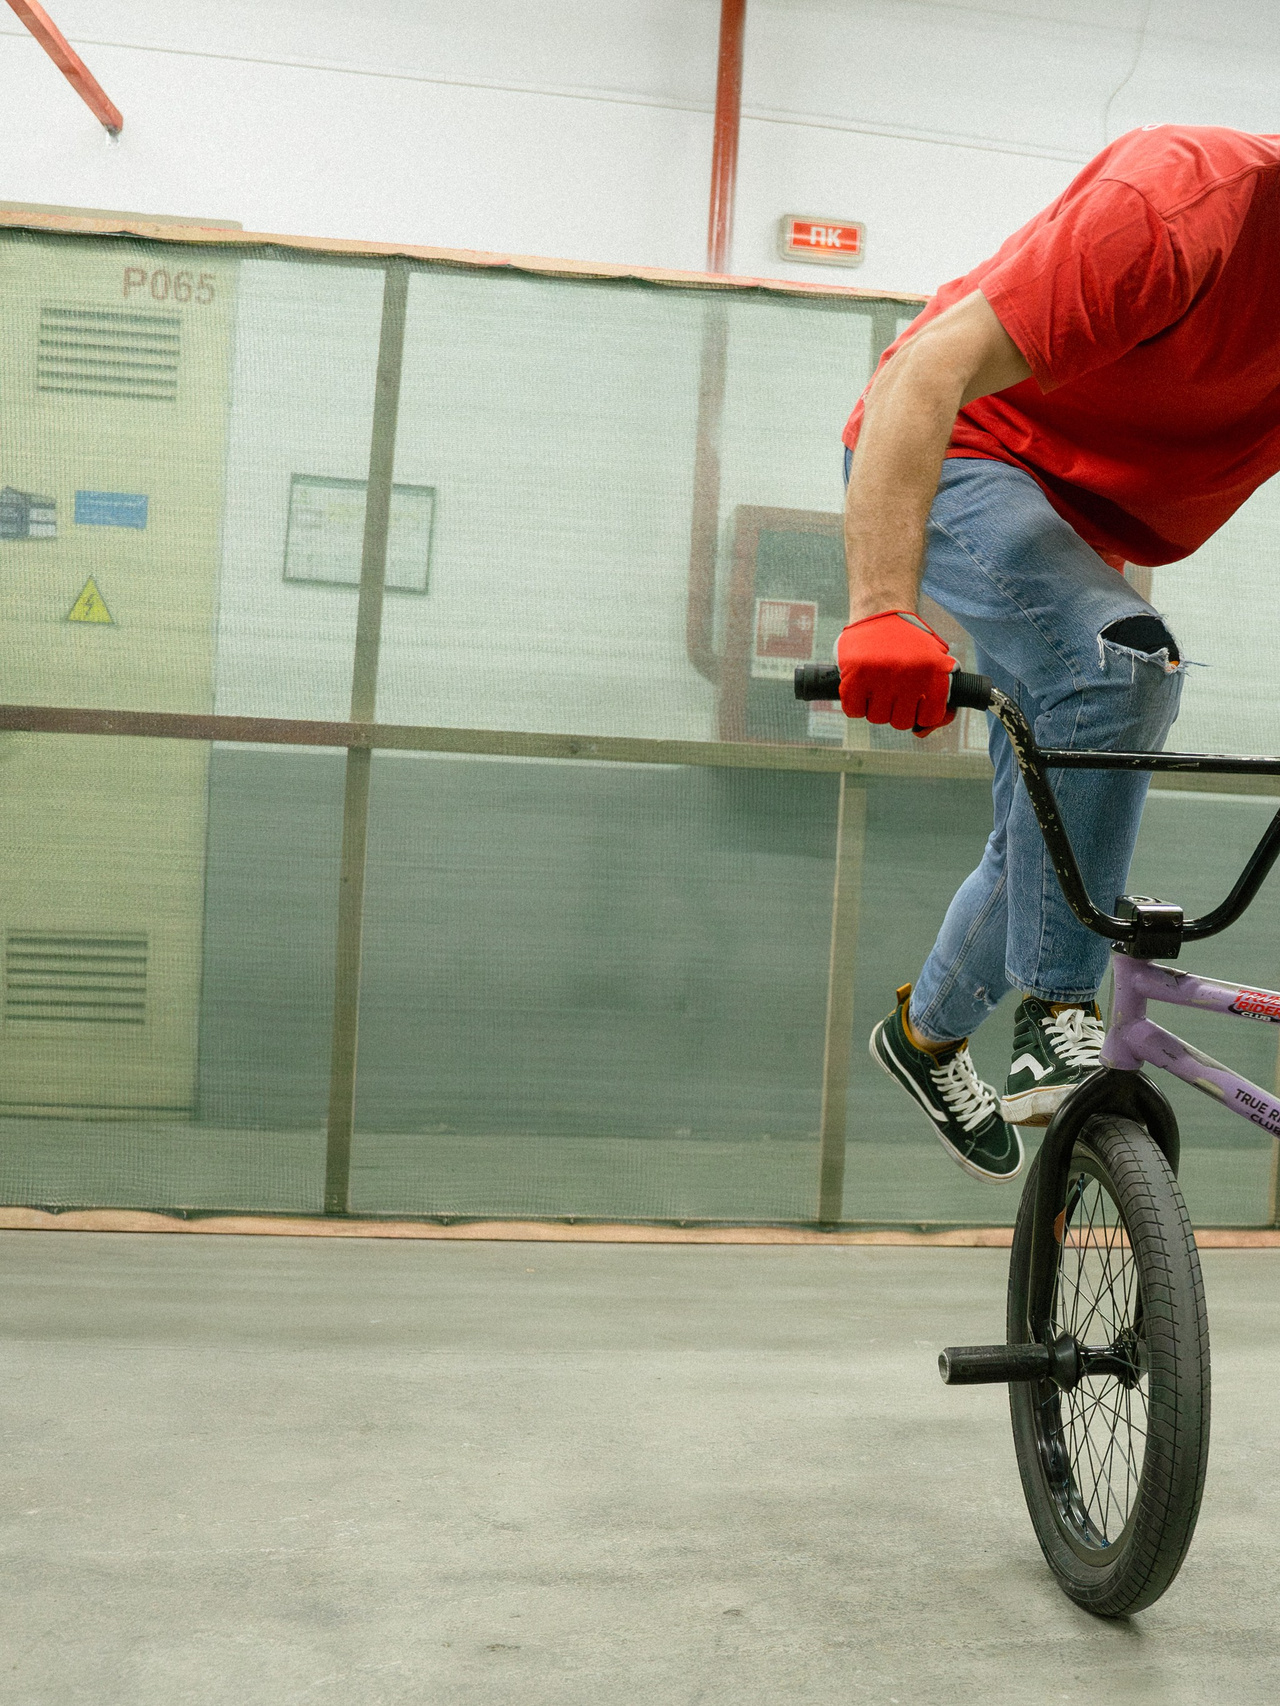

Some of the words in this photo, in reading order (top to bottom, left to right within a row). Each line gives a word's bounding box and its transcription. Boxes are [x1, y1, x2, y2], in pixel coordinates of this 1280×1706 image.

[809, 226, 842, 248] ПК
[1241, 1011, 1272, 1022] CLUB
[1234, 1088, 1269, 1115] TRUE
